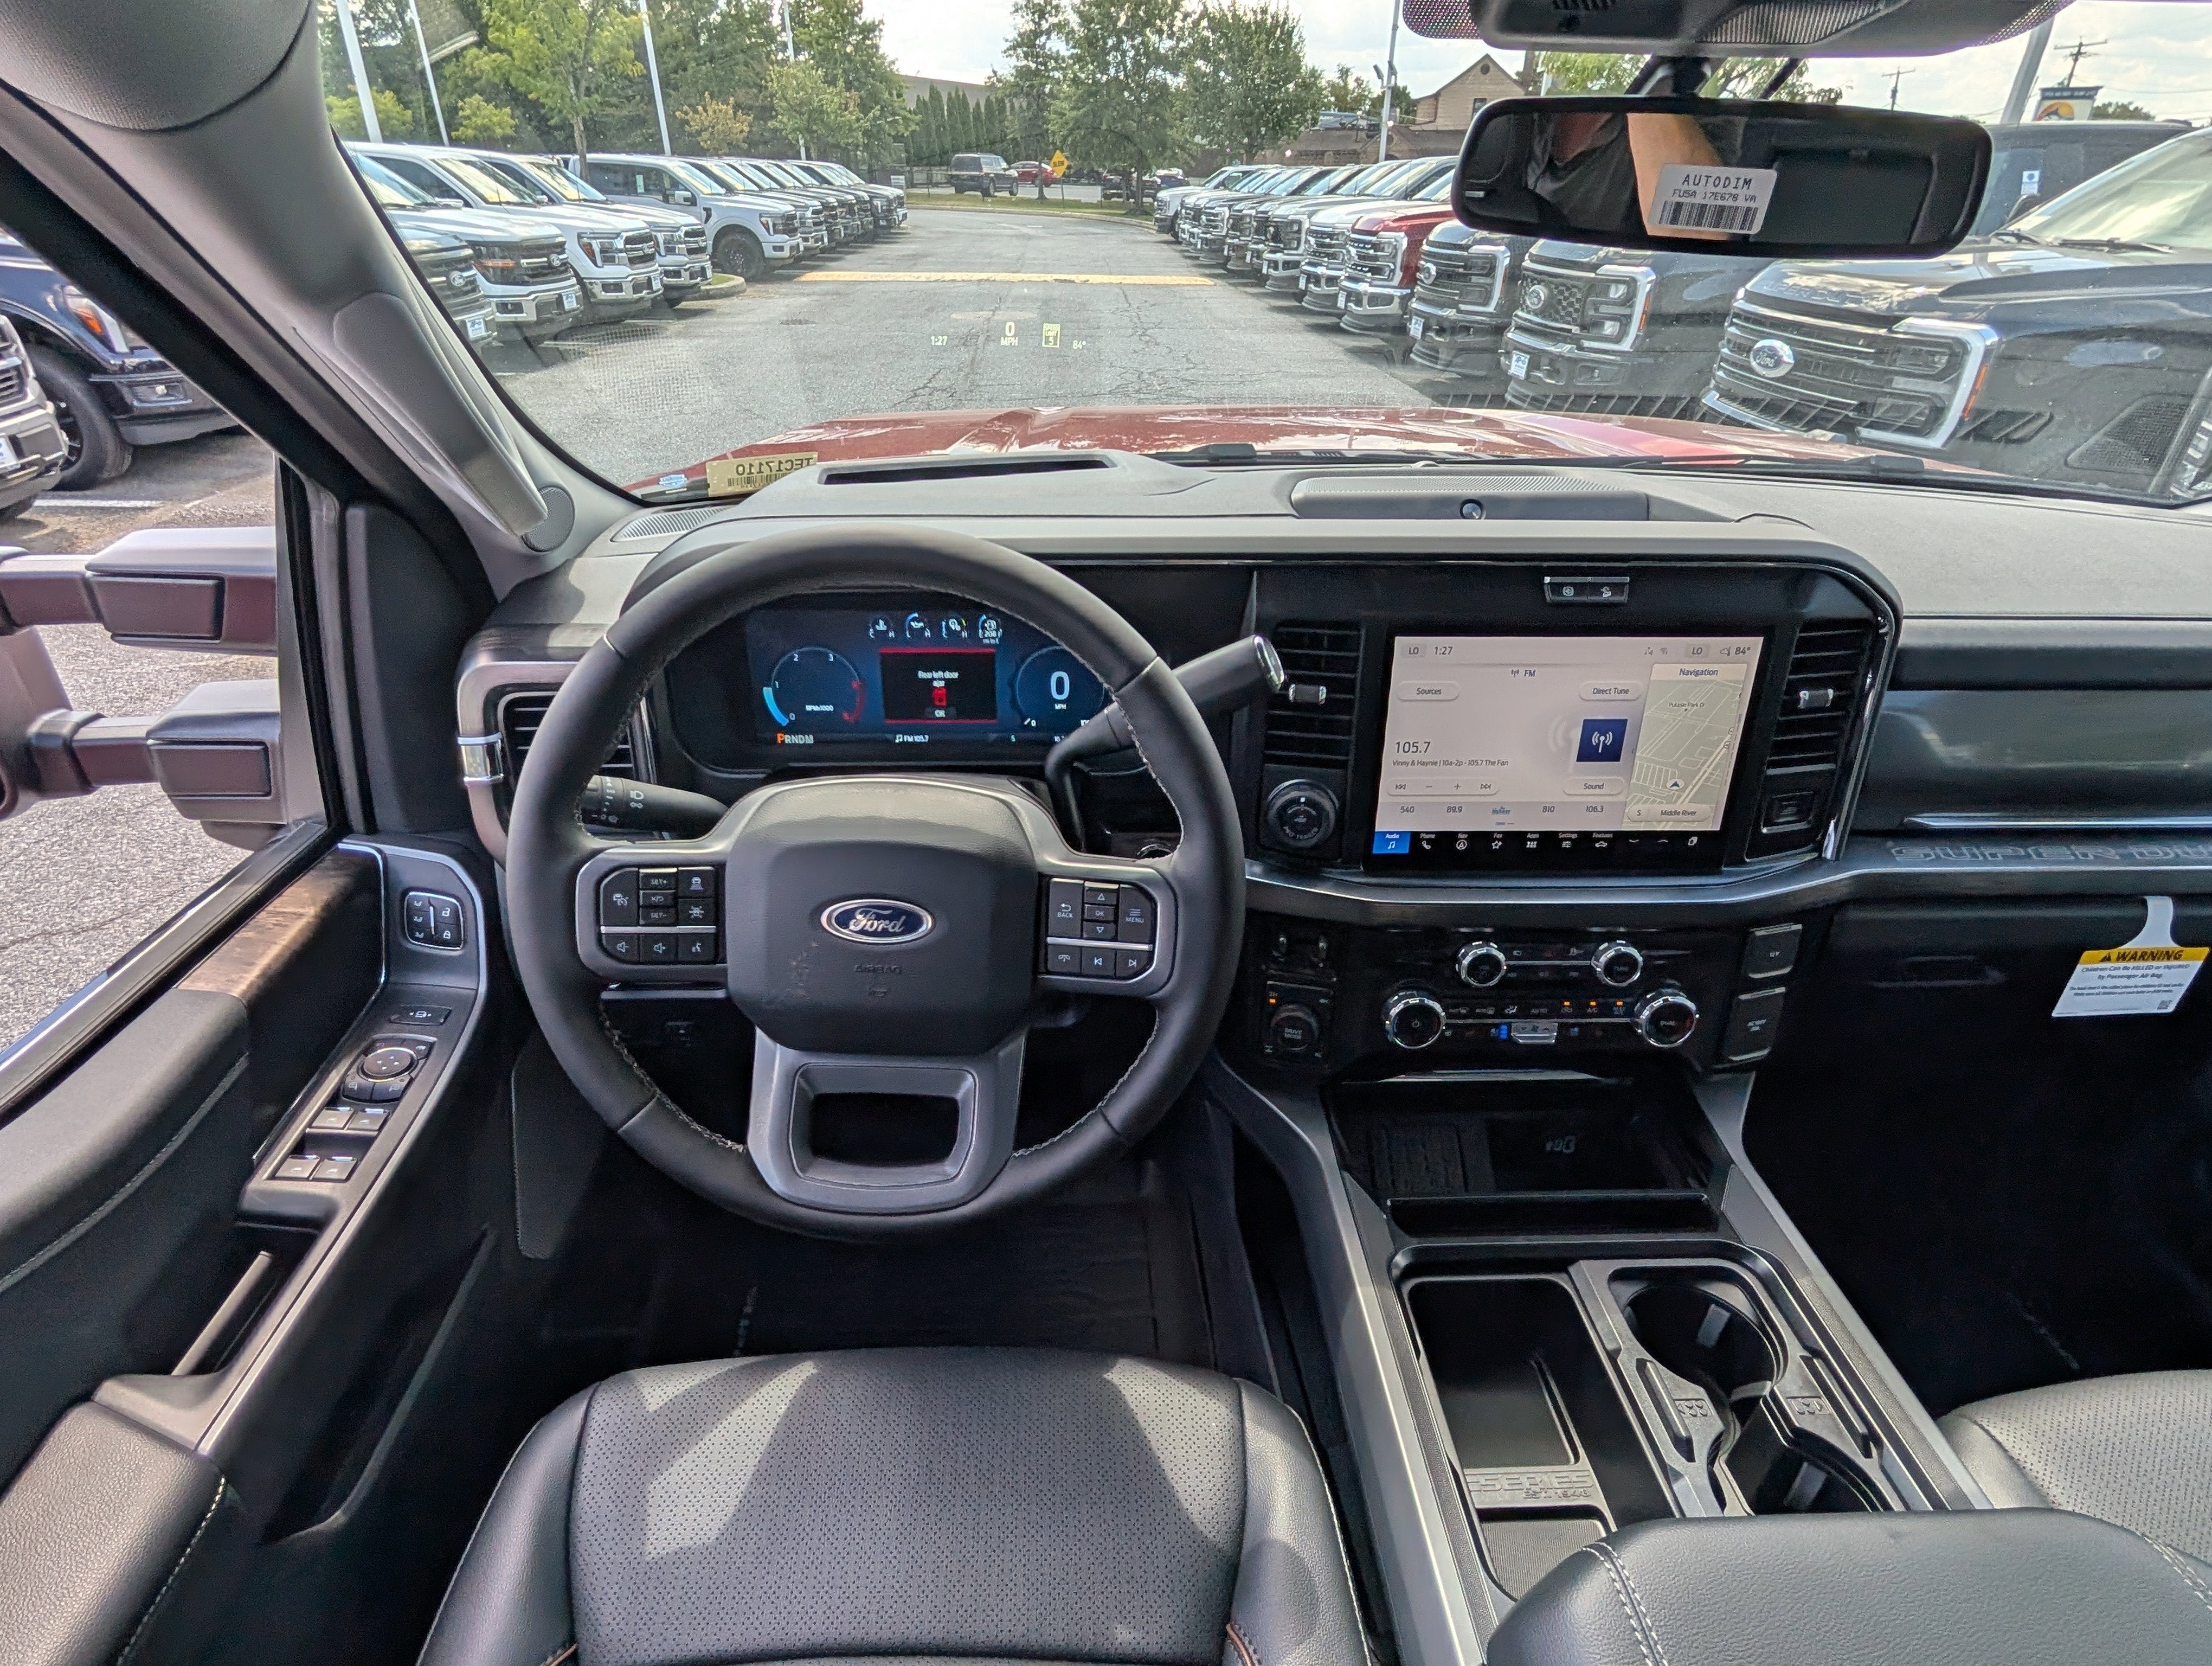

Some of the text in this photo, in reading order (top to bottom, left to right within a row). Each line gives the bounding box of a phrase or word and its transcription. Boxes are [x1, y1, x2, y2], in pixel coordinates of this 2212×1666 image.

[1682, 174, 1753, 190] AUTODIM
[1702, 191, 1739, 202] 17E678
[1005, 322, 1015, 336] 0
[931, 336, 948, 345] 1:27
[1000, 337, 1018, 345] MPH
[1049, 336, 1054, 345] 5
[1756, 348, 1778, 367] Ford
[1409, 646, 1419, 655] LO
[1433, 646, 1454, 655] 1:27
[1691, 646, 1703, 655] LO
[1734, 646, 1751, 655] 84°
[793, 653, 799, 662] 2
[828, 653, 834, 662] 3
[1679, 668, 1719, 677] Navigation
[775, 681, 779, 689] 1
[1051, 670, 1070, 700] 0
[1416, 687, 1442, 695] Sources
[789, 713, 795, 721] 0
[1395, 741, 1431, 754] 105.7
[1400, 805, 1414, 813] 540
[1446, 805, 1463, 813] 89.9
[1891, 845, 2119, 860] SUPER
[848, 907, 906, 932] Ford
[2115, 950, 2184, 962] WARNING
